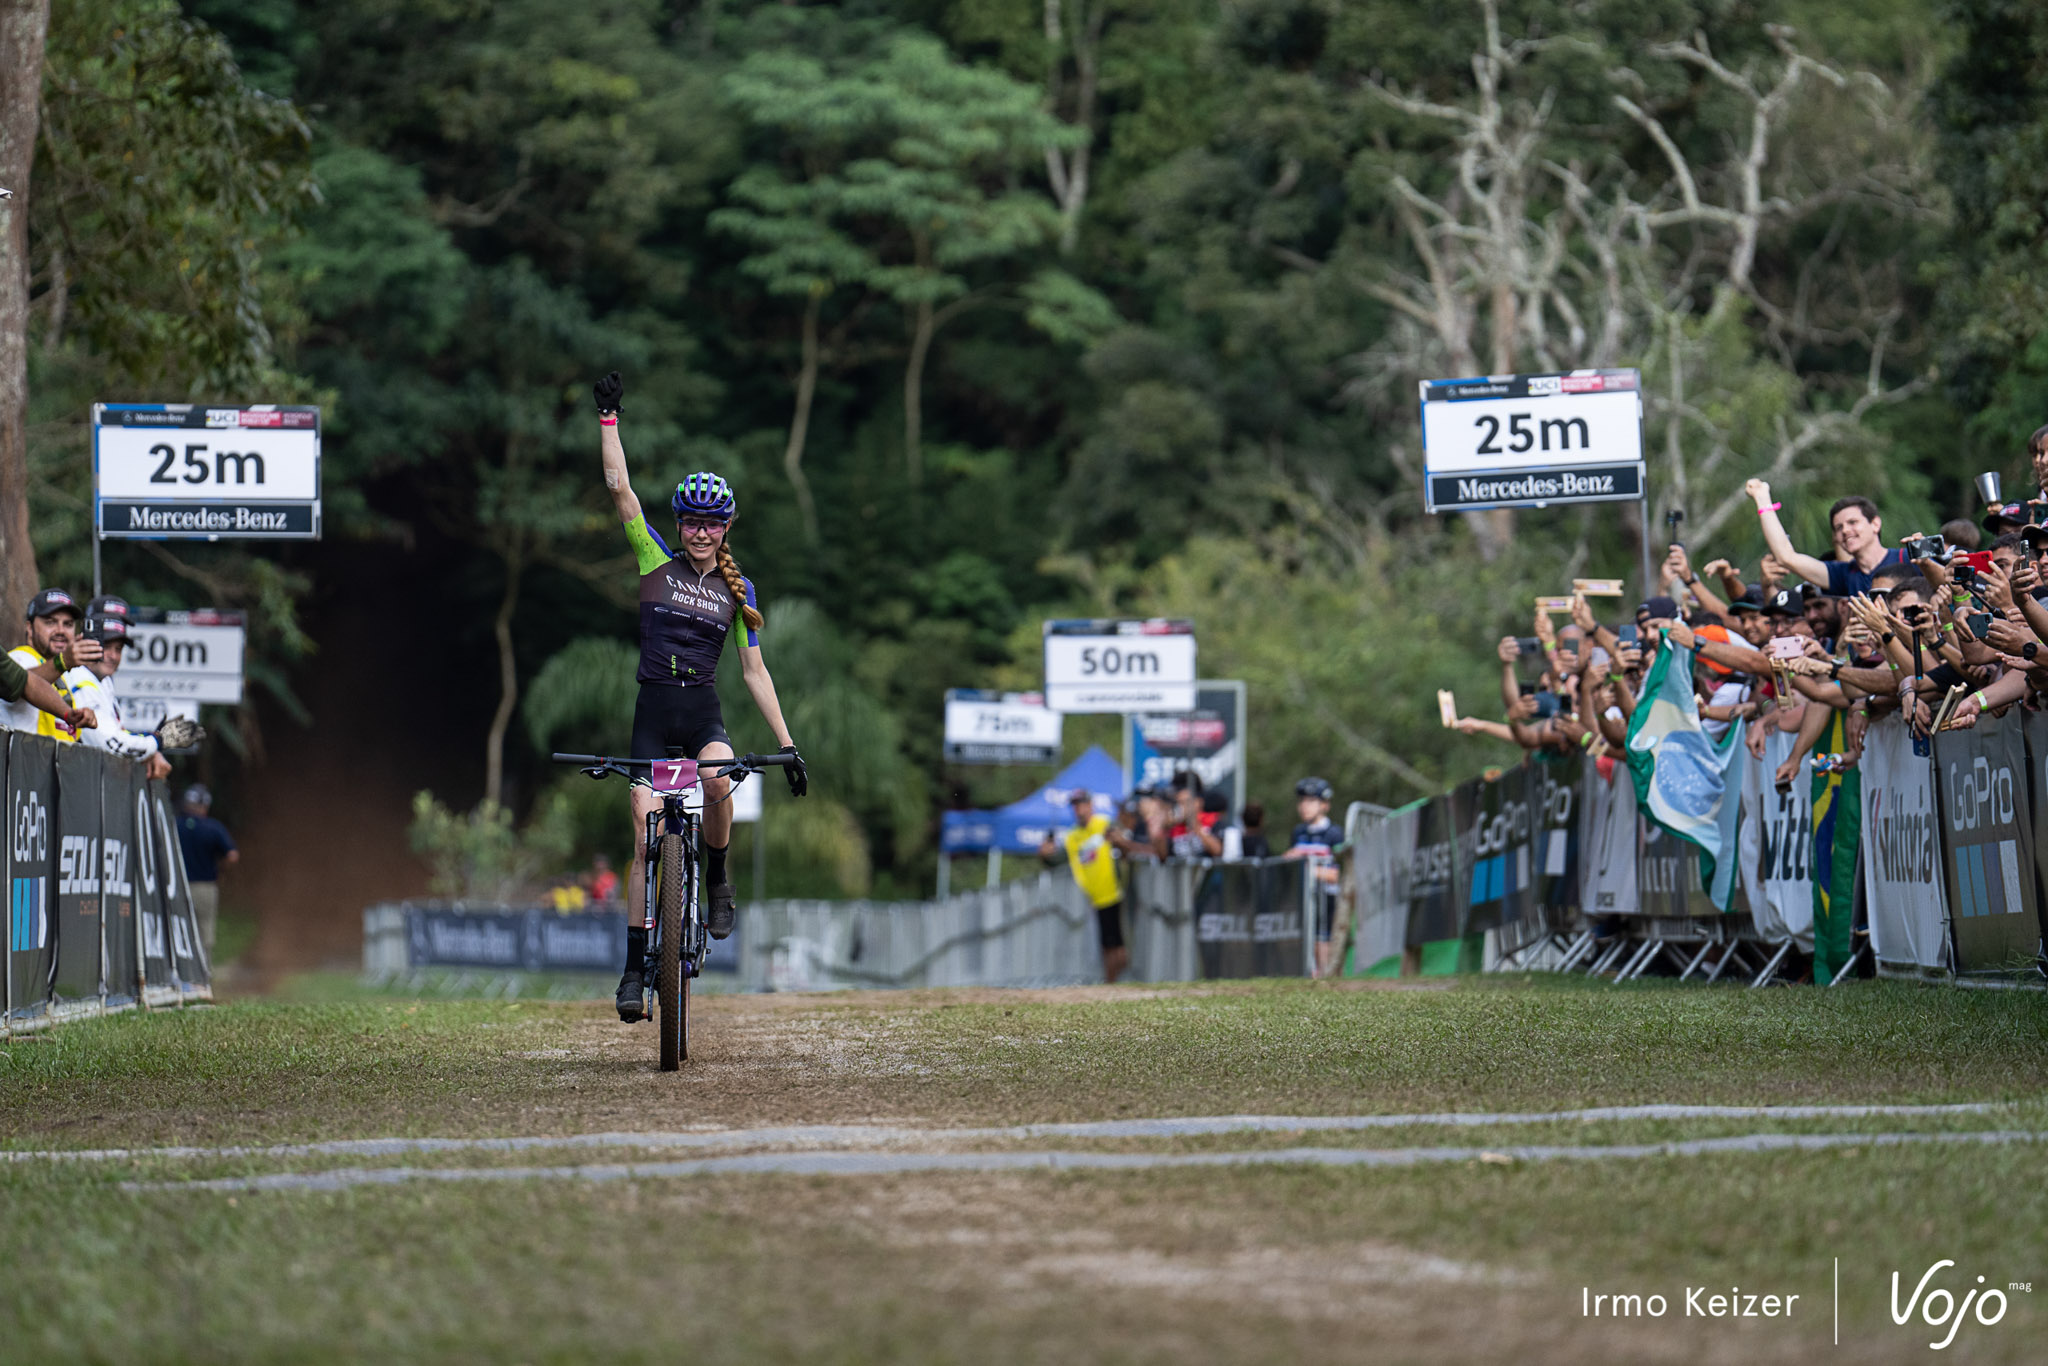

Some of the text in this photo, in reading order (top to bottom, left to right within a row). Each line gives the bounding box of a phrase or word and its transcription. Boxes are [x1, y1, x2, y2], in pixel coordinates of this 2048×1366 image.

[1475, 413, 1590, 455] 25m
[148, 443, 265, 484] 25m
[1457, 472, 1614, 501] Mercedes-Benz
[129, 506, 287, 530] Mercedes-Benz
[1081, 647, 1159, 675] 50m
[667, 765, 682, 785] 7
[1950, 756, 2014, 831] GoPro
[14, 789, 46, 863] GoPro
